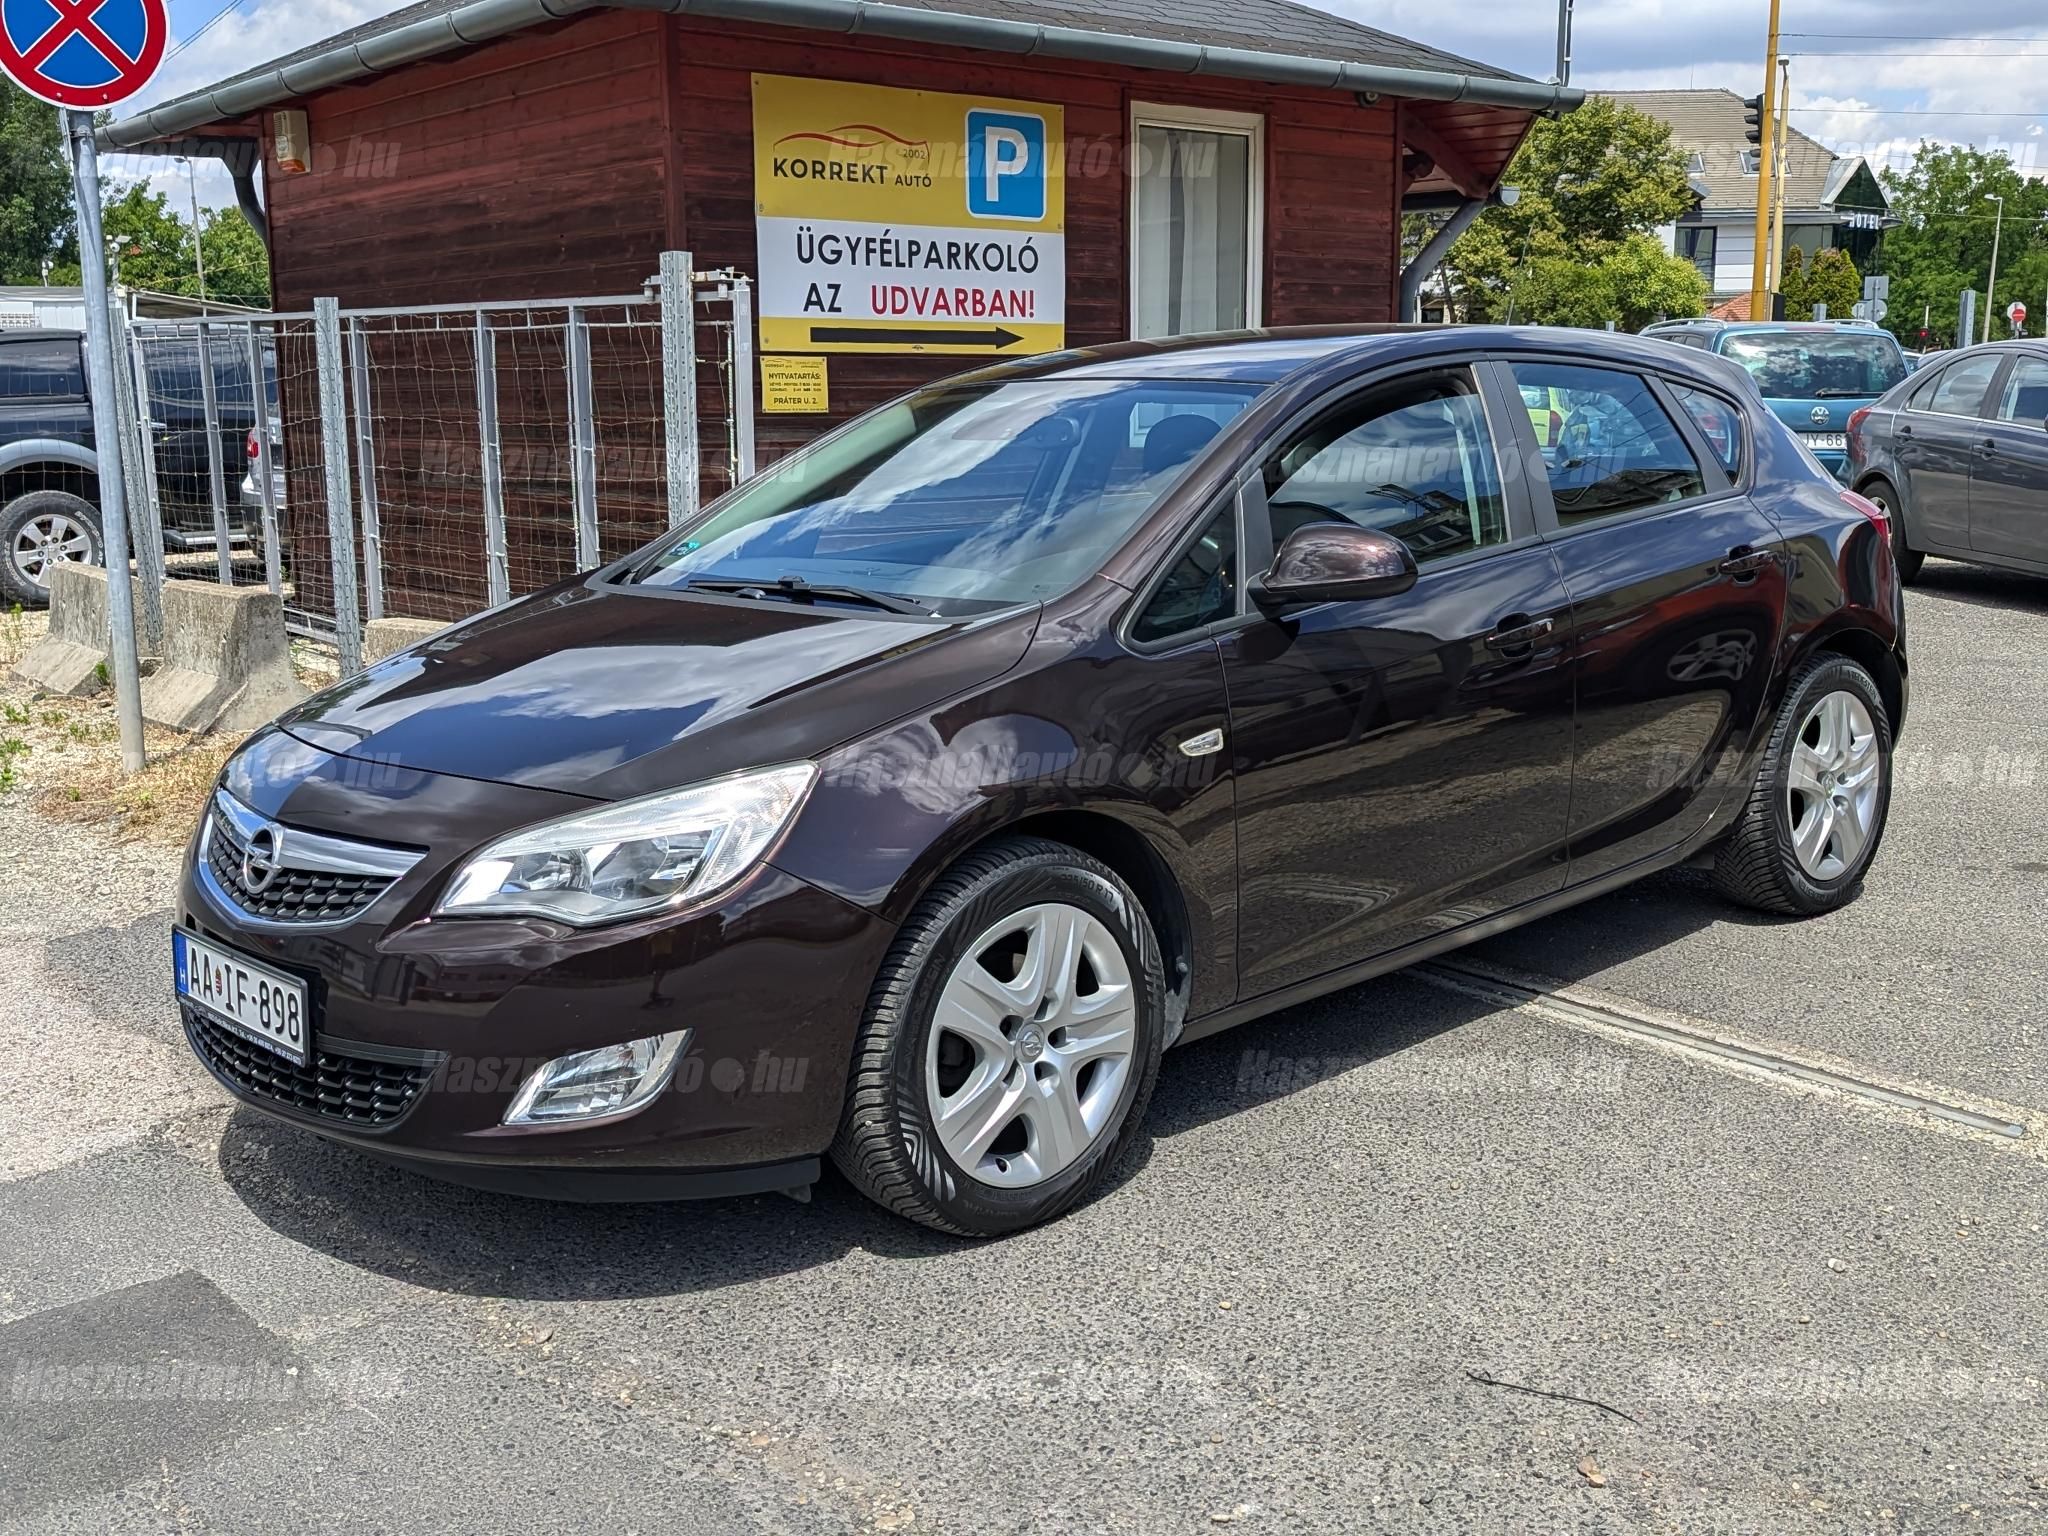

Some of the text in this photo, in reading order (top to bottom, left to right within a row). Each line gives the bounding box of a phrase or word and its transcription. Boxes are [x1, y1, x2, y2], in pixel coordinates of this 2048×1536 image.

[903, 148, 926, 159] 2002
[985, 126, 1029, 202] P
[773, 157, 932, 188] KORREKT AUTÓ
[797, 226, 1039, 273] ÜGYFÉLPARKOLÓ
[803, 283, 1035, 318] AZ UDVARBAN!
[773, 396, 802, 405] PRÁTER
[224, 963, 300, 1043] IF-898
